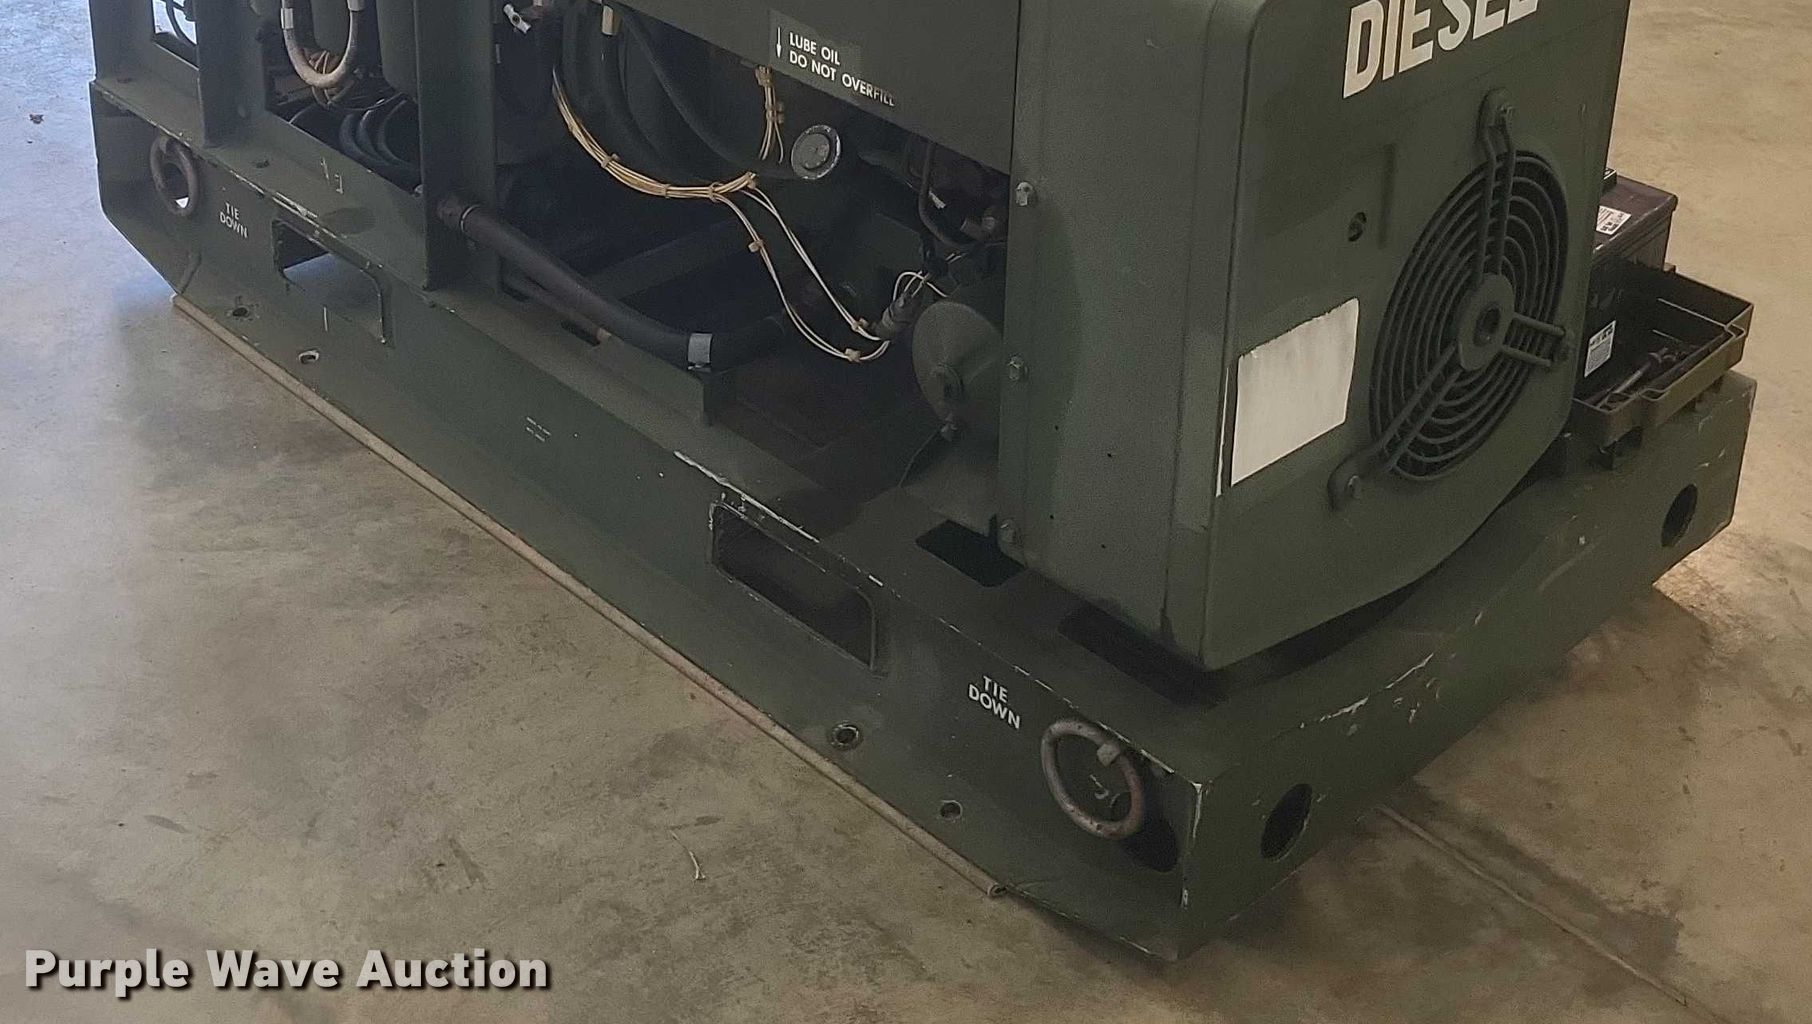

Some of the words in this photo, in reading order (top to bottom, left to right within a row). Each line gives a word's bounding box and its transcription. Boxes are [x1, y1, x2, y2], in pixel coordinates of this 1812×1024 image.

[788, 31, 817, 56] LUBE
[820, 46, 841, 66] OIL
[789, 50, 808, 68] DO
[811, 59, 837, 81] NOT
[841, 73, 895, 107] OVERFILL
[219, 211, 248, 238] DOWN
[225, 201, 240, 220] TIE
[983, 675, 1008, 704] TIE
[968, 683, 1021, 730] DOWN
